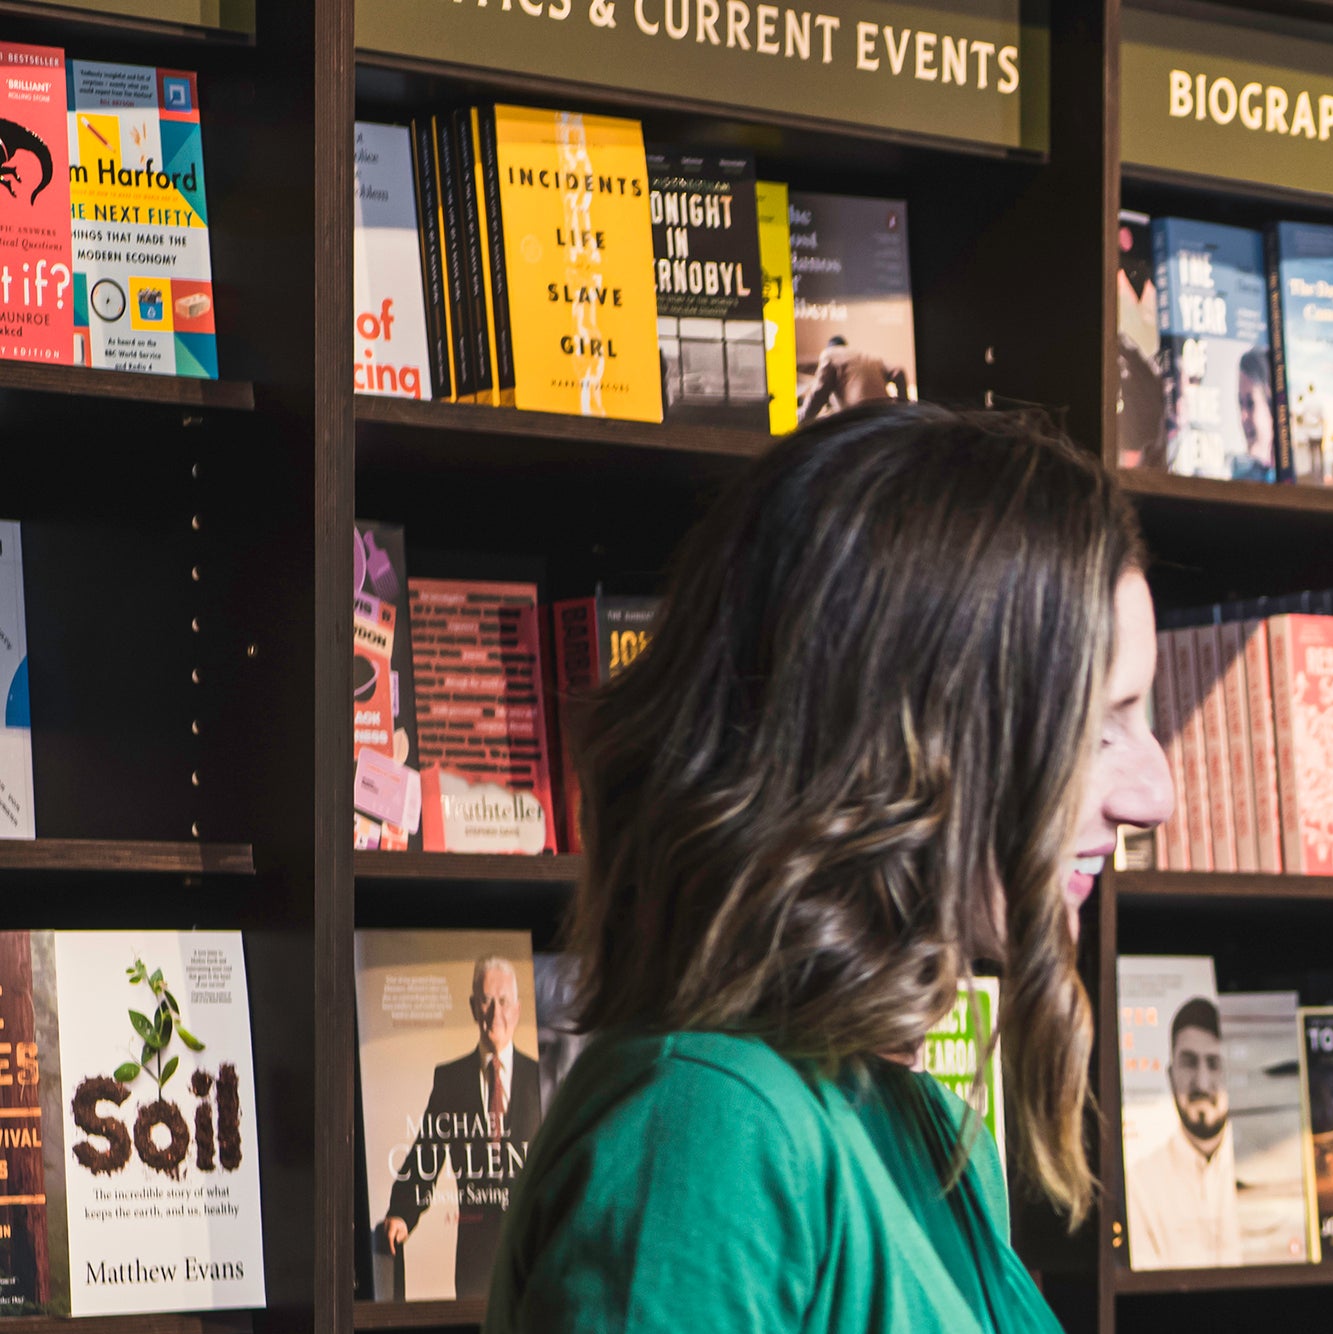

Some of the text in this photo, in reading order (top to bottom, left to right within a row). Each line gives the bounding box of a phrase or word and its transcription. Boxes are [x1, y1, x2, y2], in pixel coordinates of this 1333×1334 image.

[8, 52, 60, 67] BESTSELLER
[633, 0, 841, 64] CURRENT
[855, 20, 1021, 95] EVENTS
[97, 158, 198, 192] Harford
[508, 165, 643, 198] INCIDENTS
[94, 204, 193, 228] NEXT FIFTY
[21, 236, 63, 251] Questions
[107, 230, 187, 248] THAT MADE THE
[555, 227, 606, 250] LIFE
[666, 226, 690, 260] IN
[77, 249, 178, 266] MODERN ECONOMY
[22, 259, 70, 310] if?
[653, 258, 751, 298] RNOBYL
[547, 282, 623, 308] SLAVE
[0, 312, 50, 326] MUNROE
[356, 297, 395, 342] of
[13, 347, 60, 359] EDITION
[117, 337, 136, 346] heard
[560, 335, 618, 358] GIRL
[71, 1061, 243, 1182] Soil
[405, 1111, 512, 1138] MICHAEL
[387, 1141, 530, 1182] CULLEN
[93, 1186, 230, 1203] The incredible story of what
[466, 1181, 510, 1211] Saving
[84, 1202, 241, 1222] keeps the earth, and us, healthy
[84, 1255, 244, 1288] Matthew Evans
